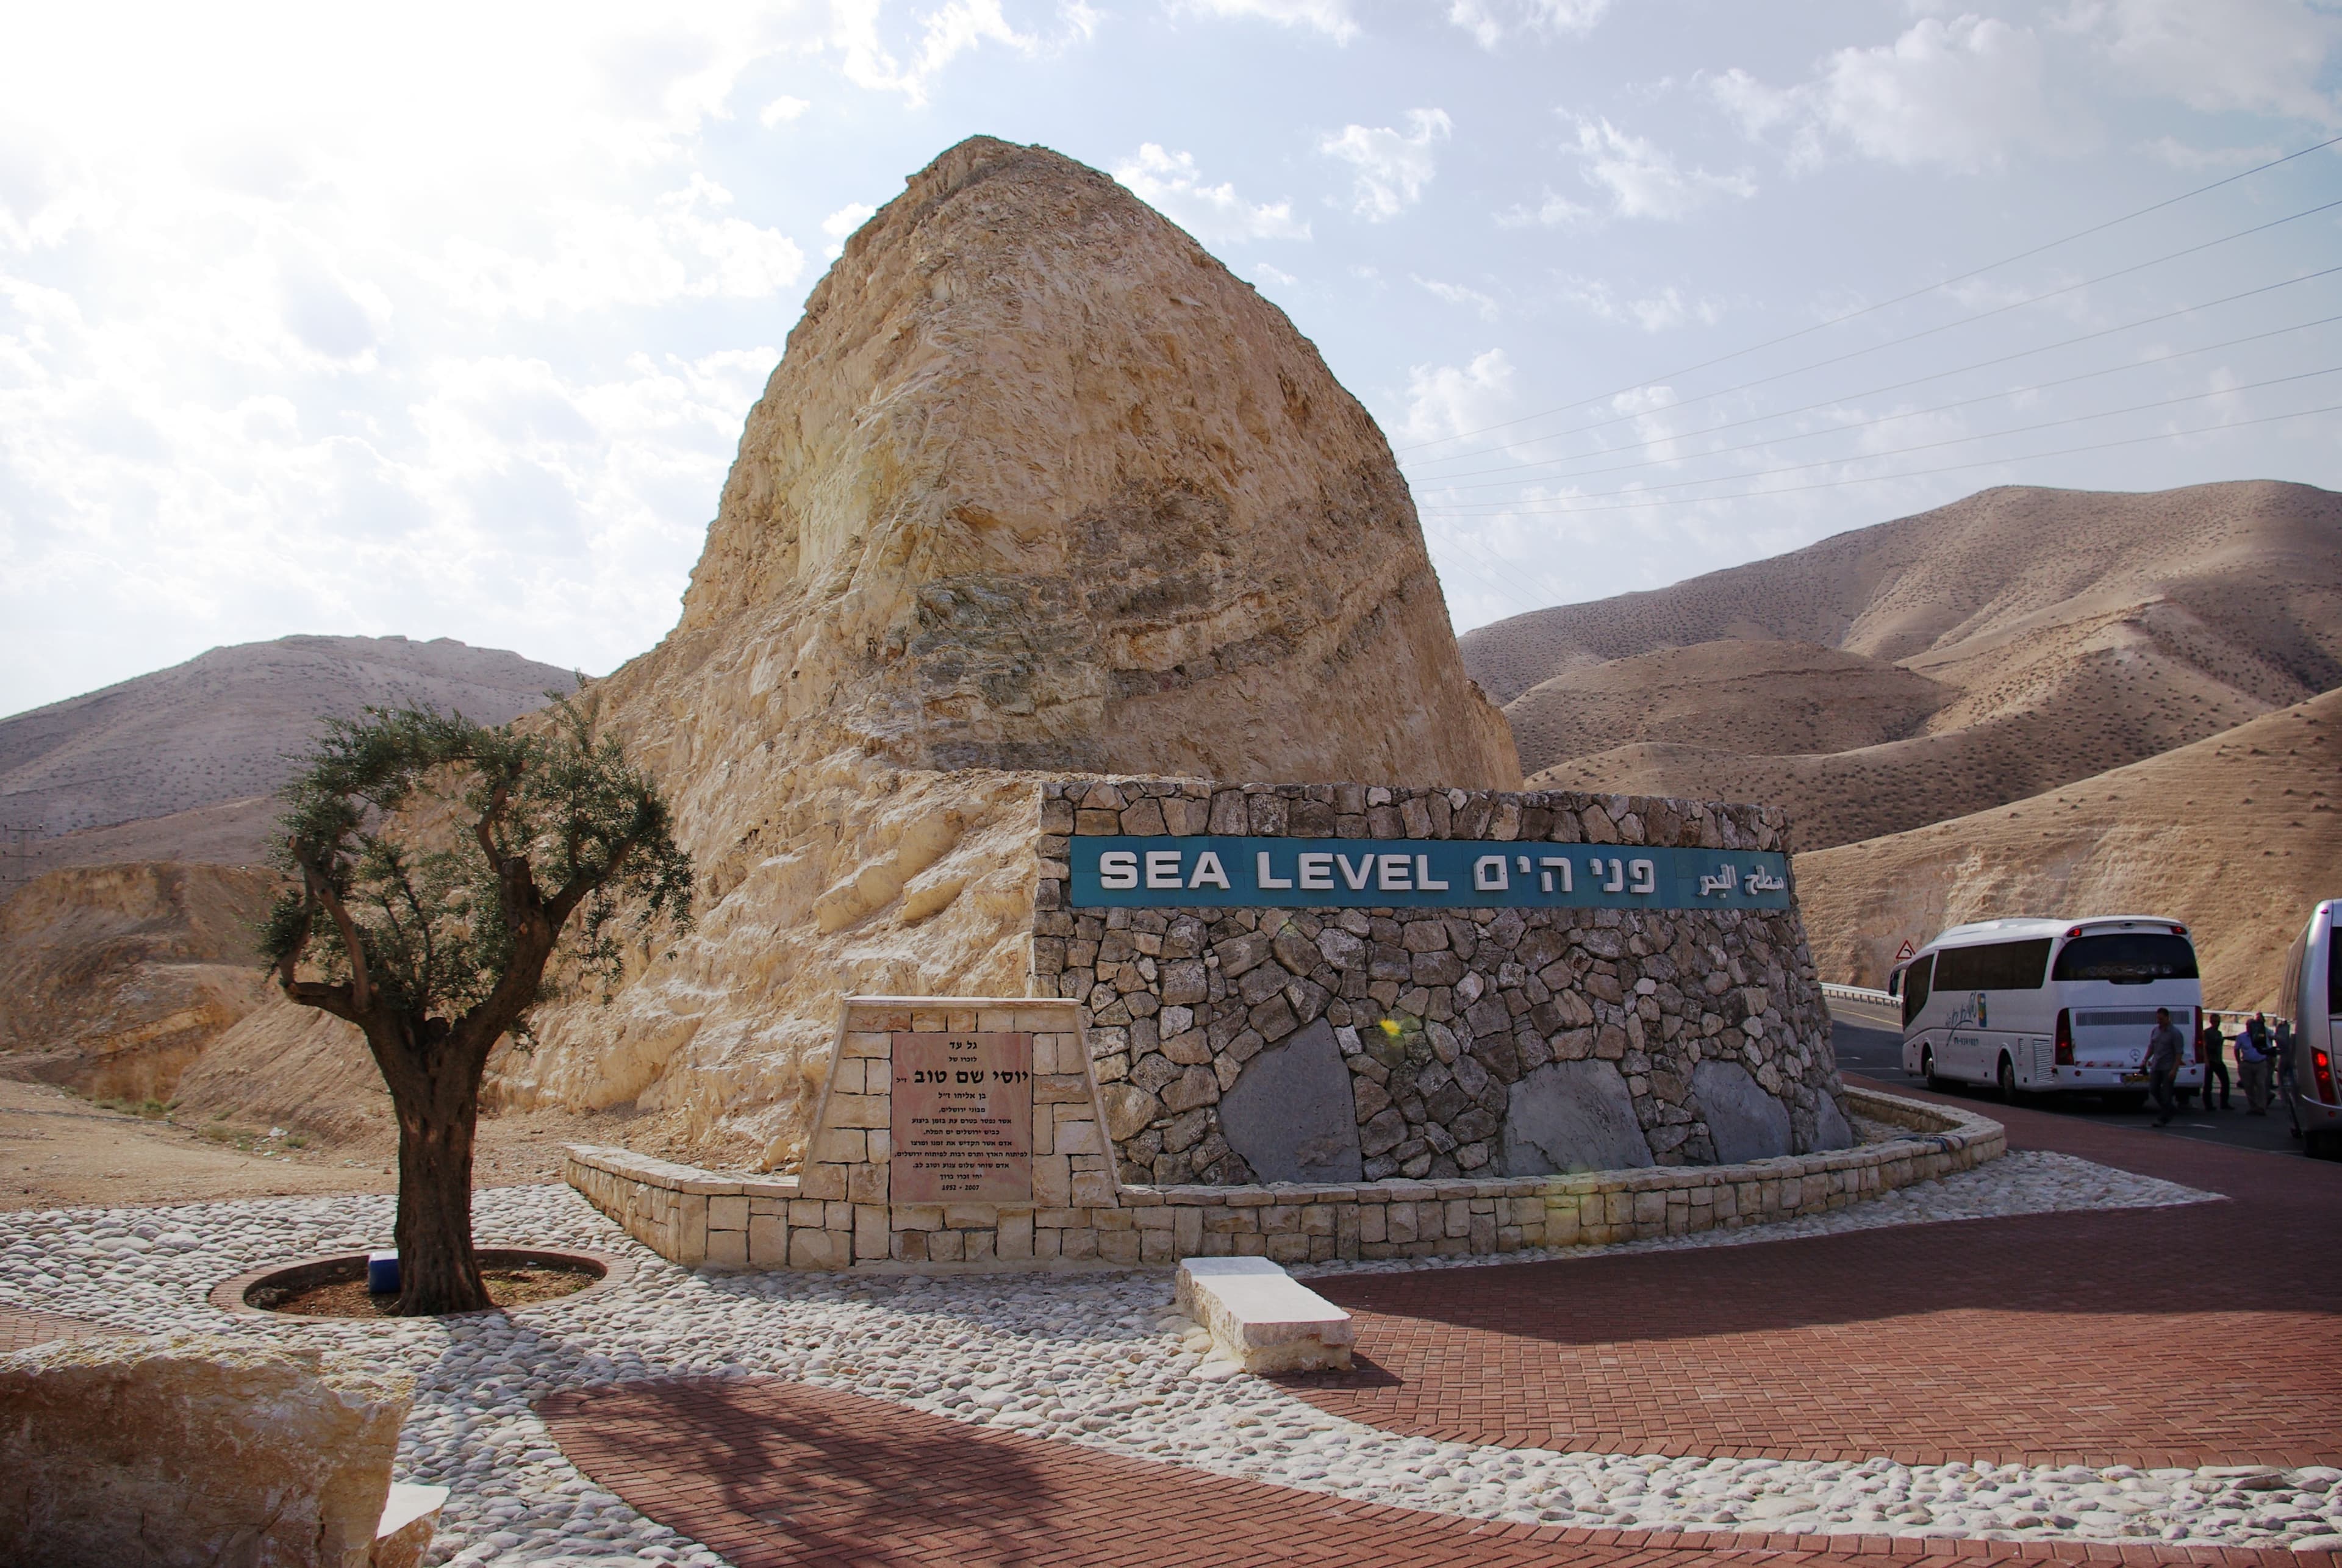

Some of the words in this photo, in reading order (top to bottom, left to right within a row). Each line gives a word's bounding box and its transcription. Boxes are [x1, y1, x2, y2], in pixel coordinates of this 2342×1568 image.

[1100, 851, 1231, 889] SEA
[1257, 851, 1449, 890] LEVEL
[1474, 855, 1573, 892] הים
[1589, 858, 1655, 893] פני
[1744, 864, 1785, 895] سطح
[948, 1040, 962, 1050] עד
[966, 1040, 978, 1050] גל
[914, 1069, 948, 1084] טוב
[954, 1069, 984, 1084] שם
[992, 1069, 1029, 1084] יוסי
[953, 1091, 976, 1101] אליהו
[978, 1091, 987, 1101] בן
